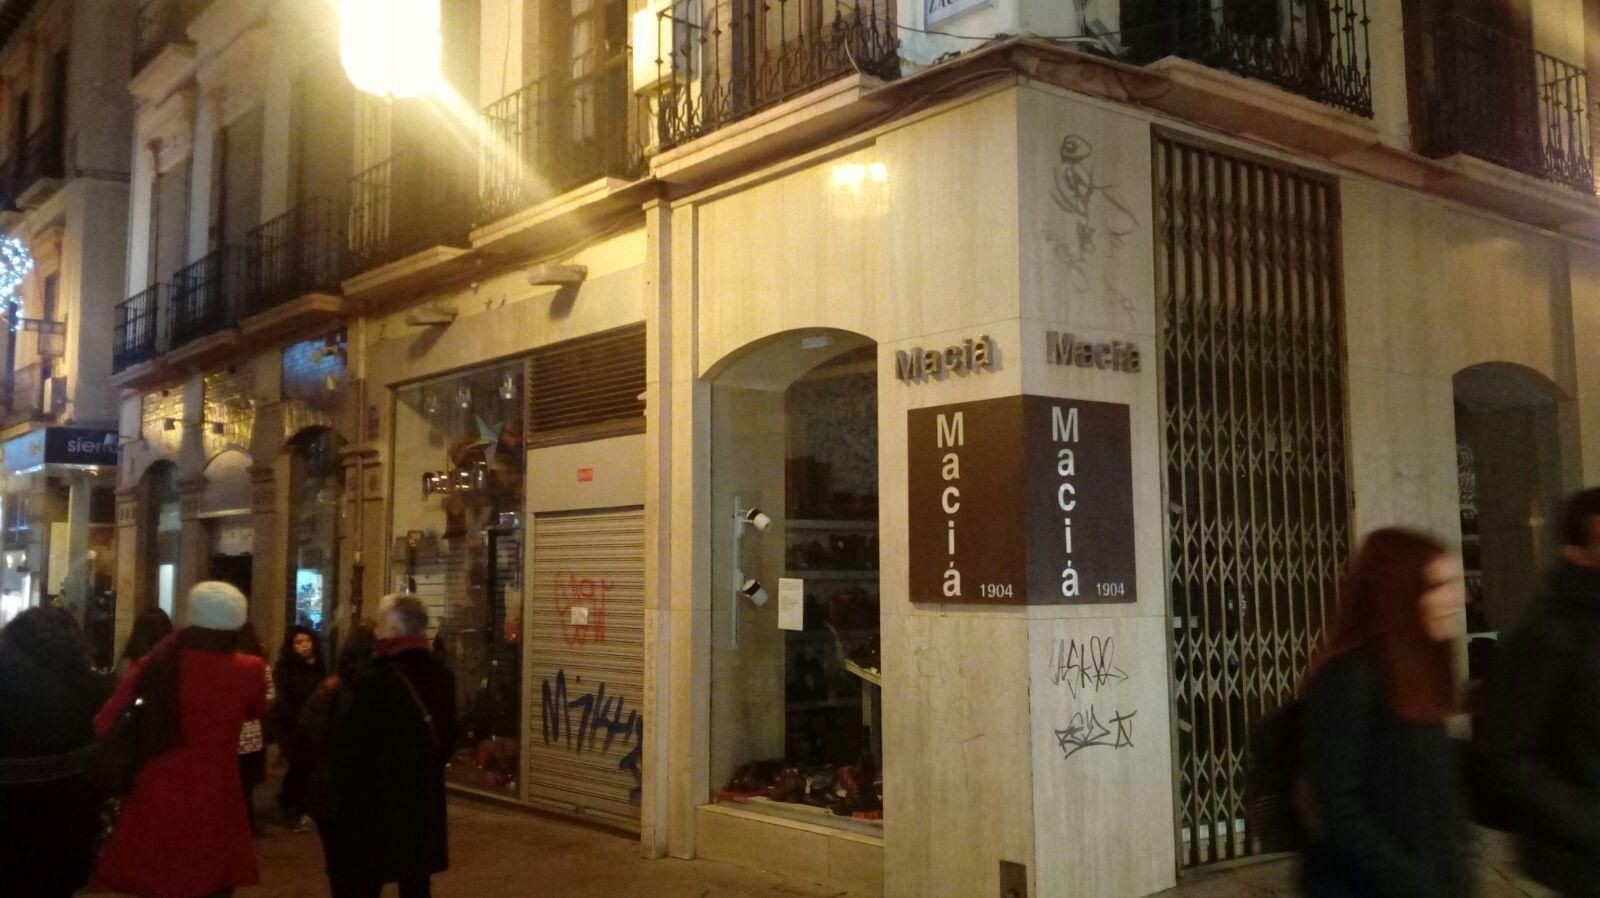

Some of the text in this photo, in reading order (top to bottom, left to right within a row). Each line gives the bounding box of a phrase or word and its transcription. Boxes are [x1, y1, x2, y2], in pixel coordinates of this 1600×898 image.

[936, 410, 965, 598] Maciá
[1051, 405, 1081, 597] Maciá
[980, 583, 1014, 599] 1904
[1095, 582, 1126, 597] 1904
